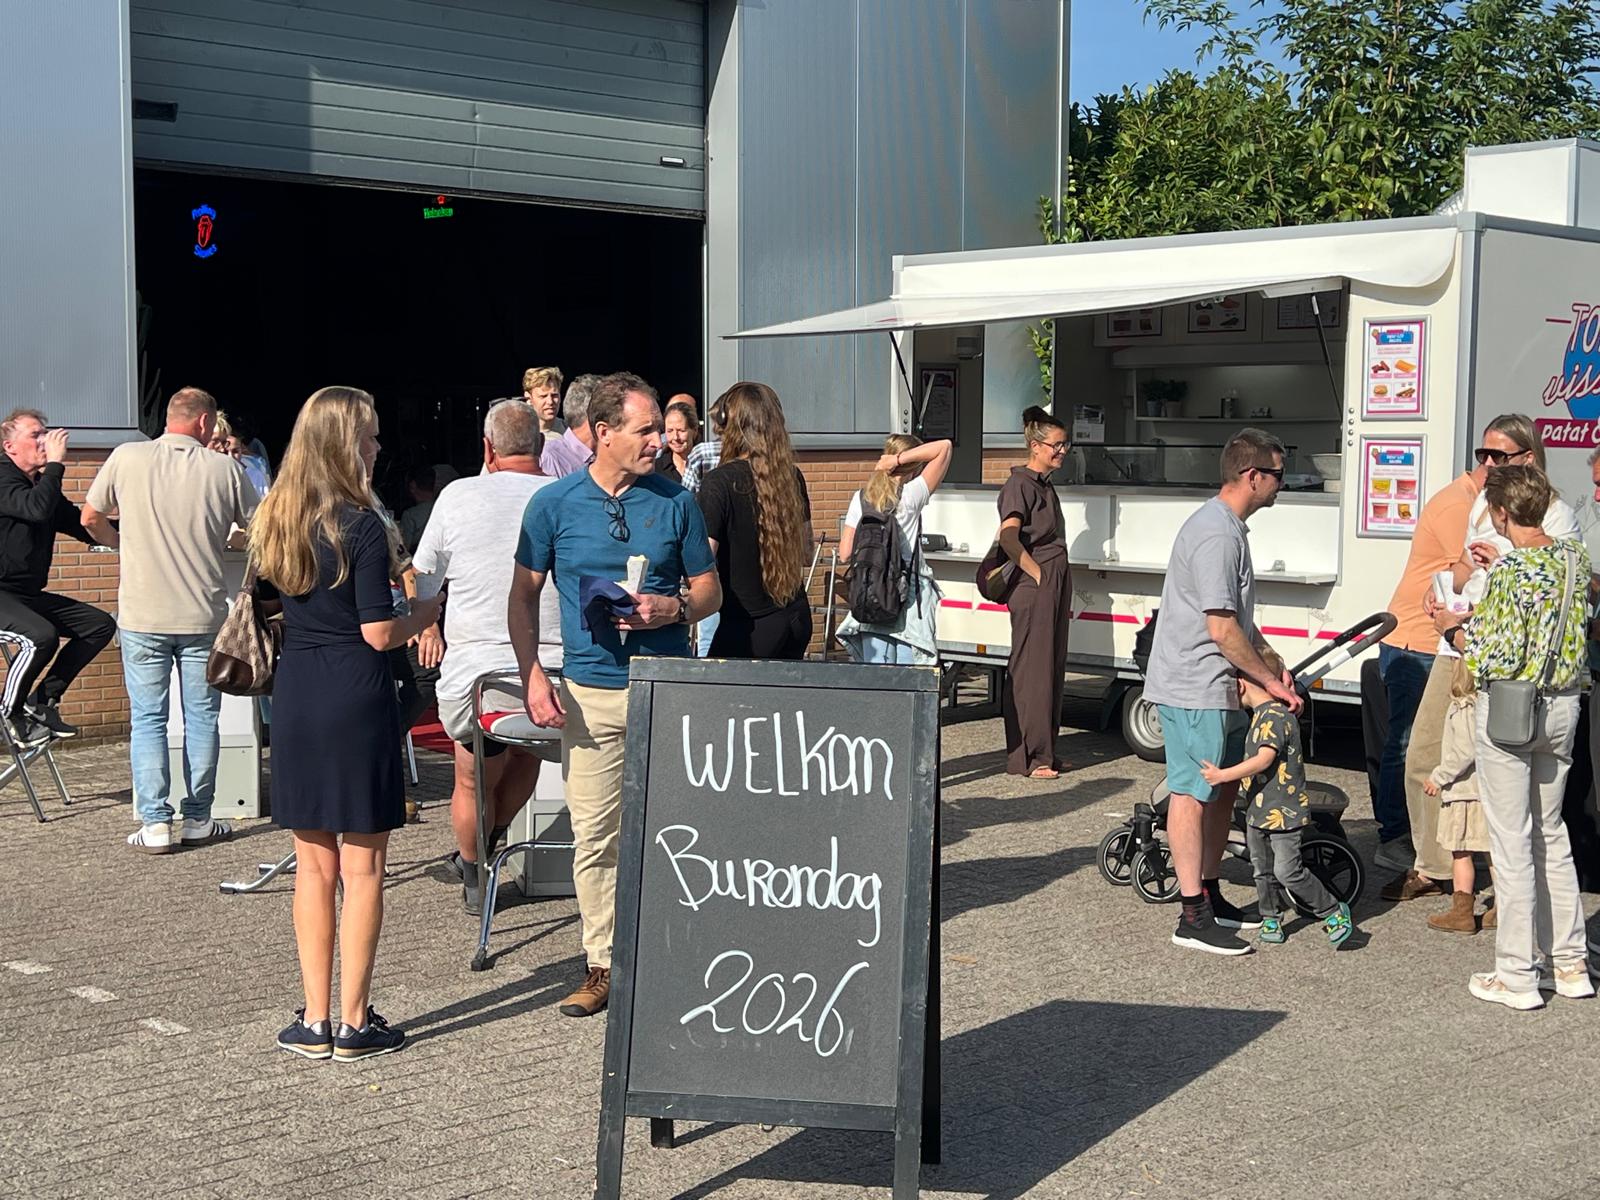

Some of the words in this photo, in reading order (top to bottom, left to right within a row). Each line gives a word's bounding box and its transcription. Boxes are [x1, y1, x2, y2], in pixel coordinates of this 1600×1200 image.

[1572, 303, 1600, 353] TO
[1541, 421, 1590, 443] patat
[680, 950, 870, 1057] 2026
